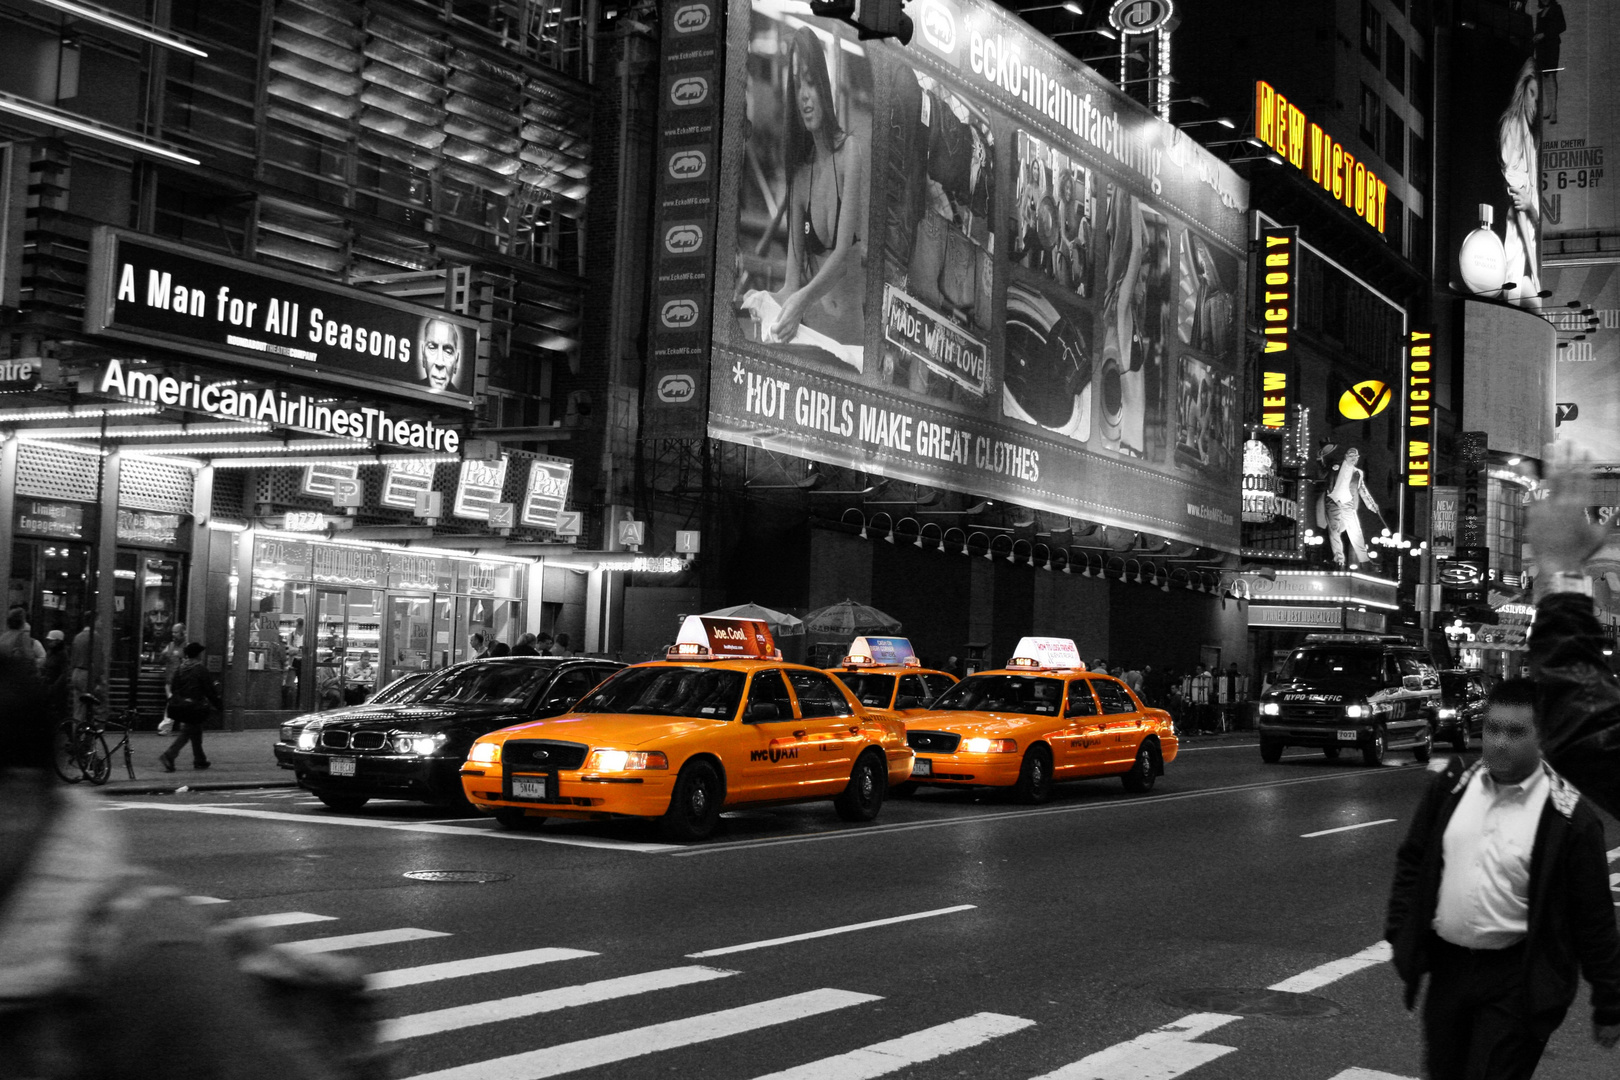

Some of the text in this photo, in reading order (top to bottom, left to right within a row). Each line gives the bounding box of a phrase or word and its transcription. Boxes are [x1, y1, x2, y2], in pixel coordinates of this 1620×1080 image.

[1561, 139, 1586, 148] CHETRY
[1257, 81, 1388, 233] NEW VICTORY
[1557, 170, 1588, 190] 6-9
[1590, 169, 1604, 178] AM
[1590, 179, 1600, 188] ET
[117, 263, 411, 363] A Man for All Seasons
[1262, 236, 1290, 427] NEW VICTORY
[890, 304, 984, 380] MADE WITH LOVE
[100, 359, 459, 453] AmericanAirlinesTheatre
[1408, 331, 1432, 486] NEW VICTORY
[795, 386, 854, 437] GIRLS
[859, 403, 913, 452] MAKE
[916, 420, 972, 465] GREAT
[975, 435, 1040, 482] CLOTHES
[466, 459, 502, 486] Pax
[533, 468, 567, 497] Pax
[1243, 473, 1284, 493] OUNG
[32, 502, 67, 518] Limited
[1436, 500, 1454, 511] NEW
[1433, 511, 1455, 521] VICTORY
[260, 615, 280, 631] Pax
[413, 624, 428, 638] Pax
[481, 630, 496, 641] Pax
[713, 626, 729, 640] Joe.
[728, 626, 748, 640] Cool.
[1308, 694, 1342, 702] TRAFFIC
[750, 749, 769, 762] NYC
